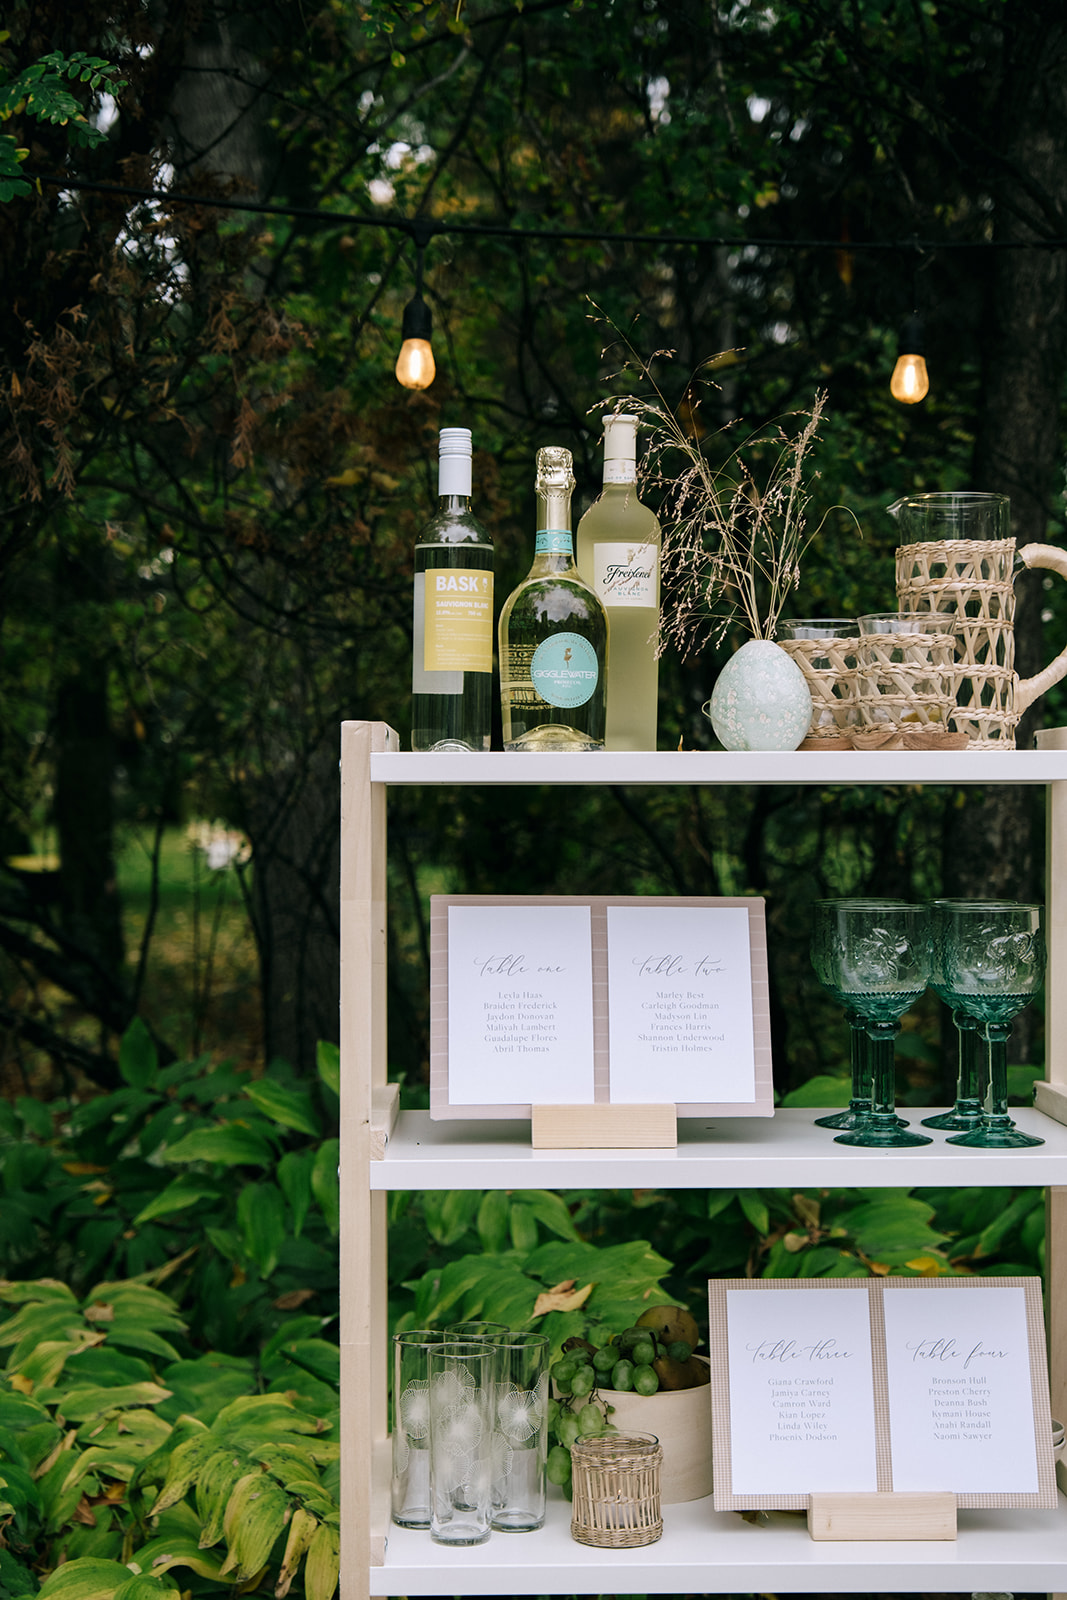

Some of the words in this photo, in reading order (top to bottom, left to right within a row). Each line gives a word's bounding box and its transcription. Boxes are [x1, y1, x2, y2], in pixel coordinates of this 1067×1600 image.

[435, 575, 479, 592] BASK
[435, 601, 473, 609] SAUVIGNON
[533, 669, 597, 680] GIGGLEWATER
[656, 992, 684, 1001] Marley
[483, 1002, 515, 1010] Braiden
[518, 1002, 558, 1010] Frederick
[641, 1002, 677, 1011] Carleigh
[679, 1002, 720, 1010] Goodman
[486, 1013, 515, 1022] Jaydon
[654, 1013, 691, 1022] Madyson
[650, 1023, 682, 1031] Frances
[685, 1023, 712, 1031] Harris
[484, 1034, 529, 1043] Guadalupe
[531, 1034, 558, 1042] Flores
[493, 1045, 514, 1053] Abril
[516, 1045, 550, 1053] Thomas
[794, 1377, 834, 1385] Crawford
[932, 1377, 967, 1385] Bronson
[771, 1389, 799, 1399] Jamiya
[800, 1389, 831, 1398] Carney
[928, 1388, 960, 1396] Preston
[962, 1388, 991, 1397] Cherry
[808, 1400, 831, 1408] Ward
[934, 1399, 965, 1407] Deanna
[778, 1411, 798, 1419] Kian
[800, 1411, 826, 1420] Lopez
[931, 1410, 963, 1420] Kymani
[965, 1410, 991, 1418] House
[777, 1422, 801, 1430] Linda
[803, 1422, 828, 1432] Wiley
[960, 1421, 991, 1429] Randall
[769, 1433, 803, 1441] Phoenix
[805, 1432, 838, 1441] Dodson
[962, 1432, 992, 1442] Sawyer
